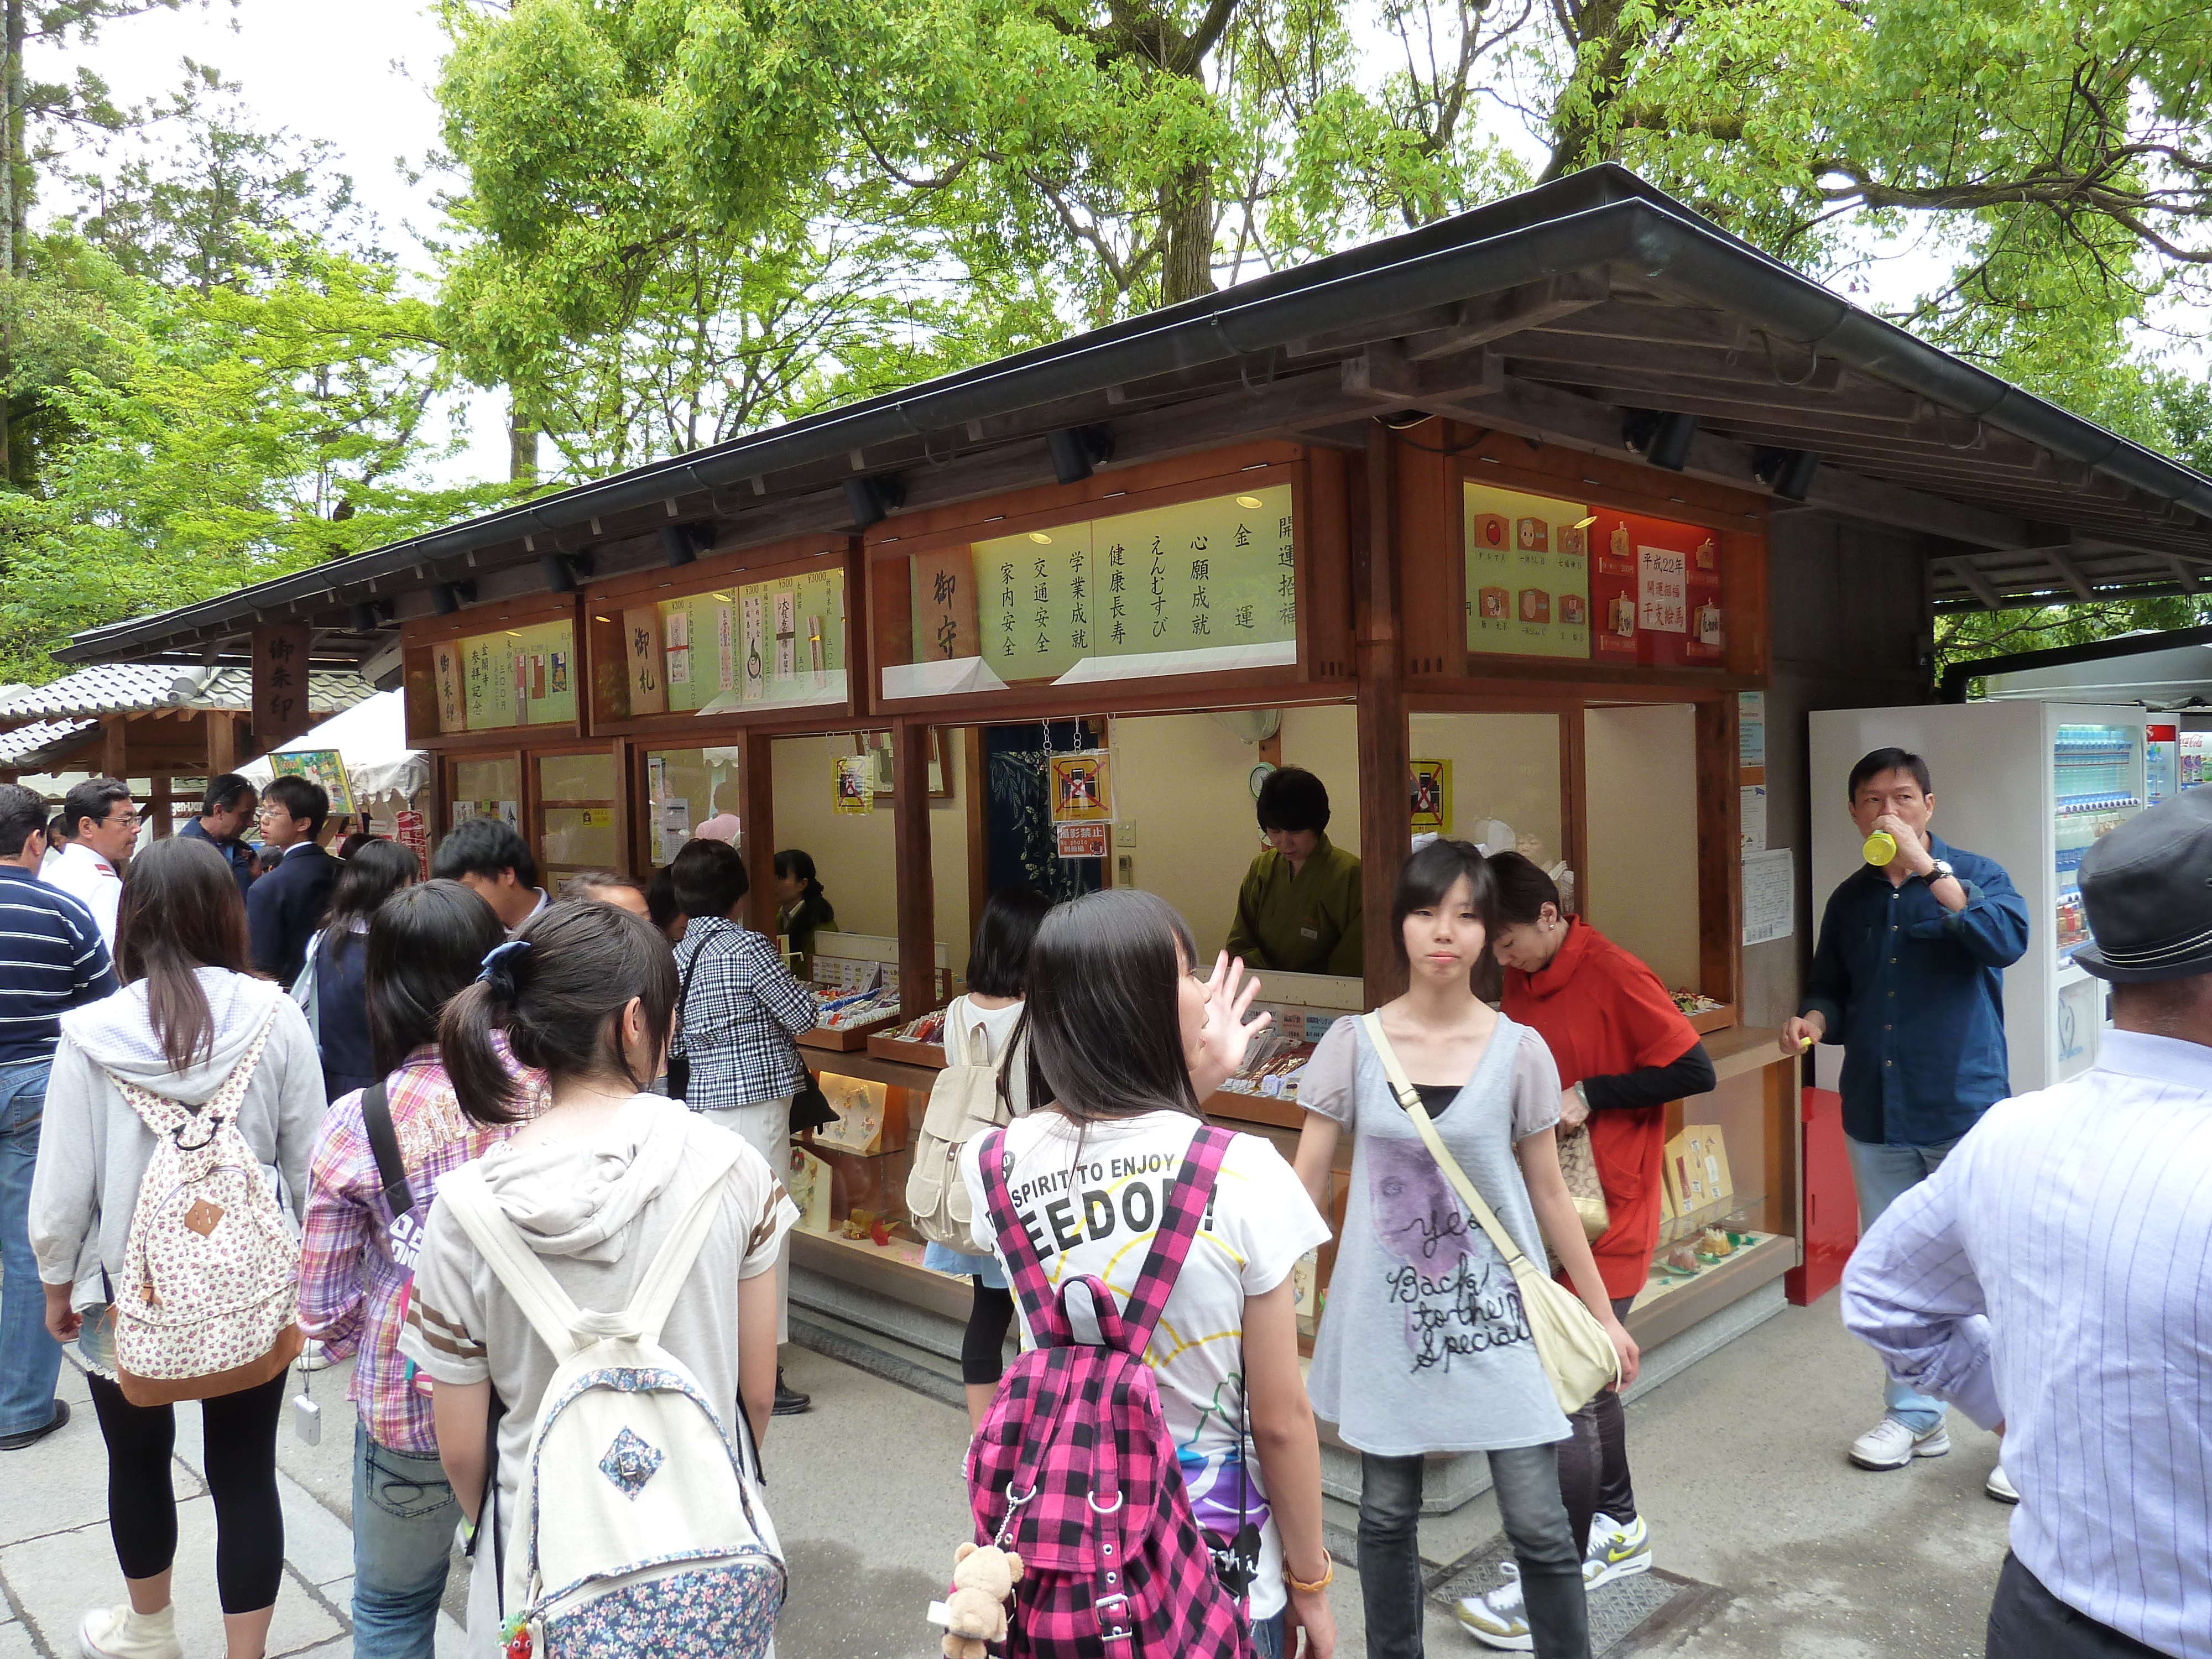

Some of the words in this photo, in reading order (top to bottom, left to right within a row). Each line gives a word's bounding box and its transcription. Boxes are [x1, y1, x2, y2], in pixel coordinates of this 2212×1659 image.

[745, 585, 759, 594] ¥300
[779, 578, 793, 588] ¥500
[1108, 545, 1126, 645] 健康長寿
[1150, 535, 1166, 637] えんむすび
[1190, 535, 1211, 635] 心願成就
[1642, 553, 1683, 576] 平成22年
[1647, 581, 1680, 599] 開運招福
[933, 568, 956, 659] 御守
[1000, 562, 1016, 656] 家内安全
[1033, 557, 1050, 653] 交通安全
[1068, 551, 1088, 649] 学業成就
[1643, 602, 1684, 628] 干支絵馬
[269, 637, 294, 722] 御朱印
[440, 653, 454, 722] 御朱印
[471, 650, 483, 715] 参拝記念
[481, 642, 489, 686] 金閣寺
[634, 627, 655, 695] 御札
[1060, 827, 1103, 839] 撮影禁止
[1011, 1168, 1069, 1208] SPIRIT
[1077, 1162, 1103, 1184] TO
[1112, 1153, 1175, 1178] ENJOY
